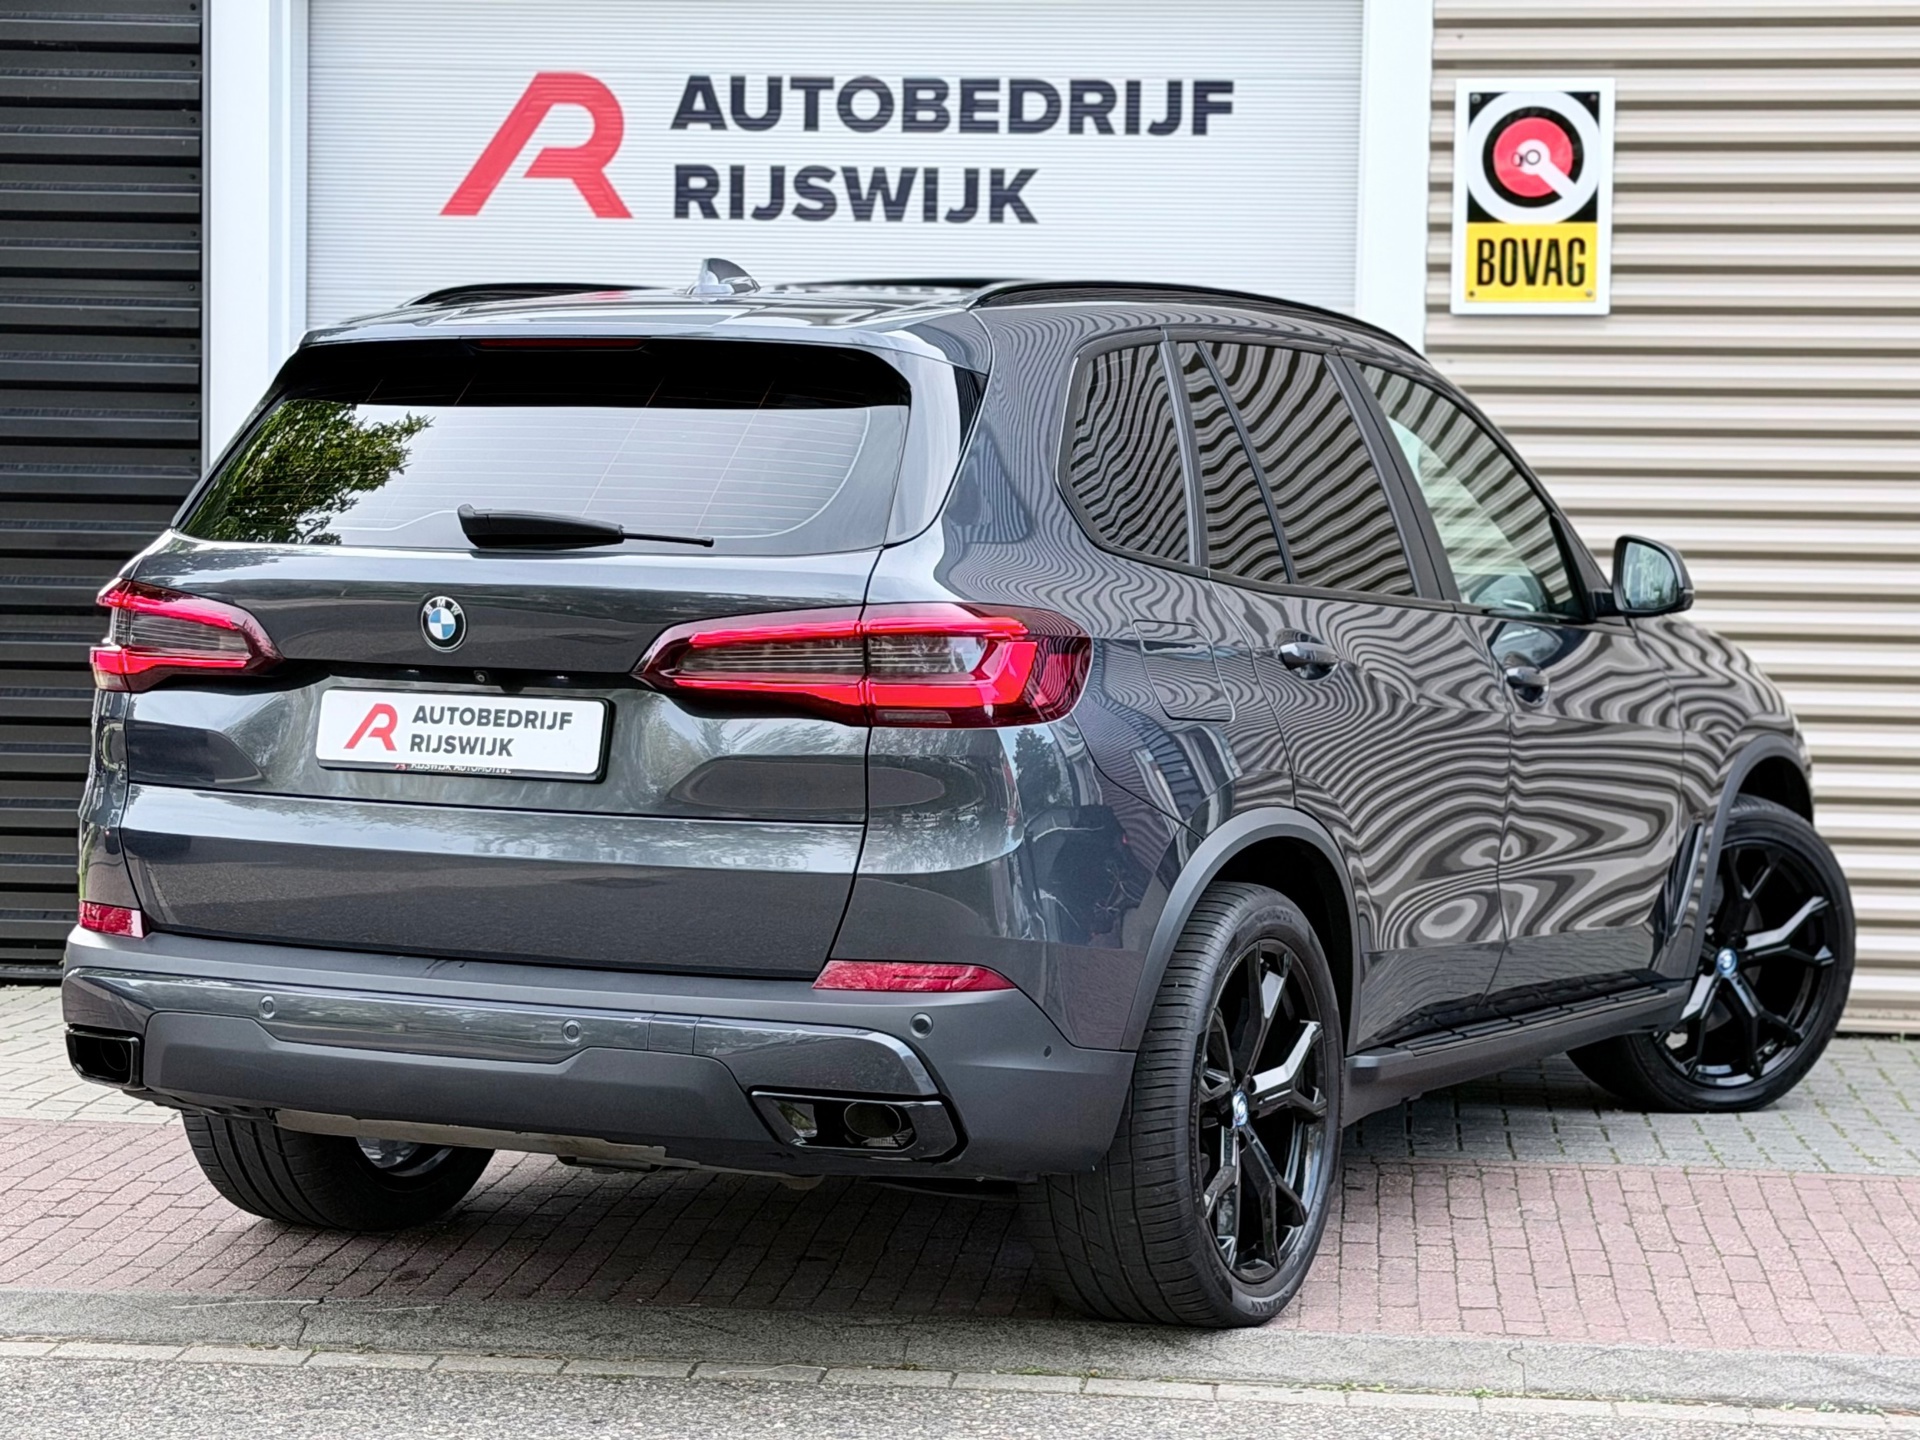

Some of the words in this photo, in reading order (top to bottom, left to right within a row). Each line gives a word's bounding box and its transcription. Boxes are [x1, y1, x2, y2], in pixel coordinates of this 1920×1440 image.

[670, 75, 1235, 136] AUTOBEDRIJF
[674, 164, 1038, 224] RIJSWIJK
[1476, 237, 1587, 287] BOVAG
[412, 705, 573, 731] AUTOBEDRIJF
[409, 733, 514, 757] RIJSWIJK
